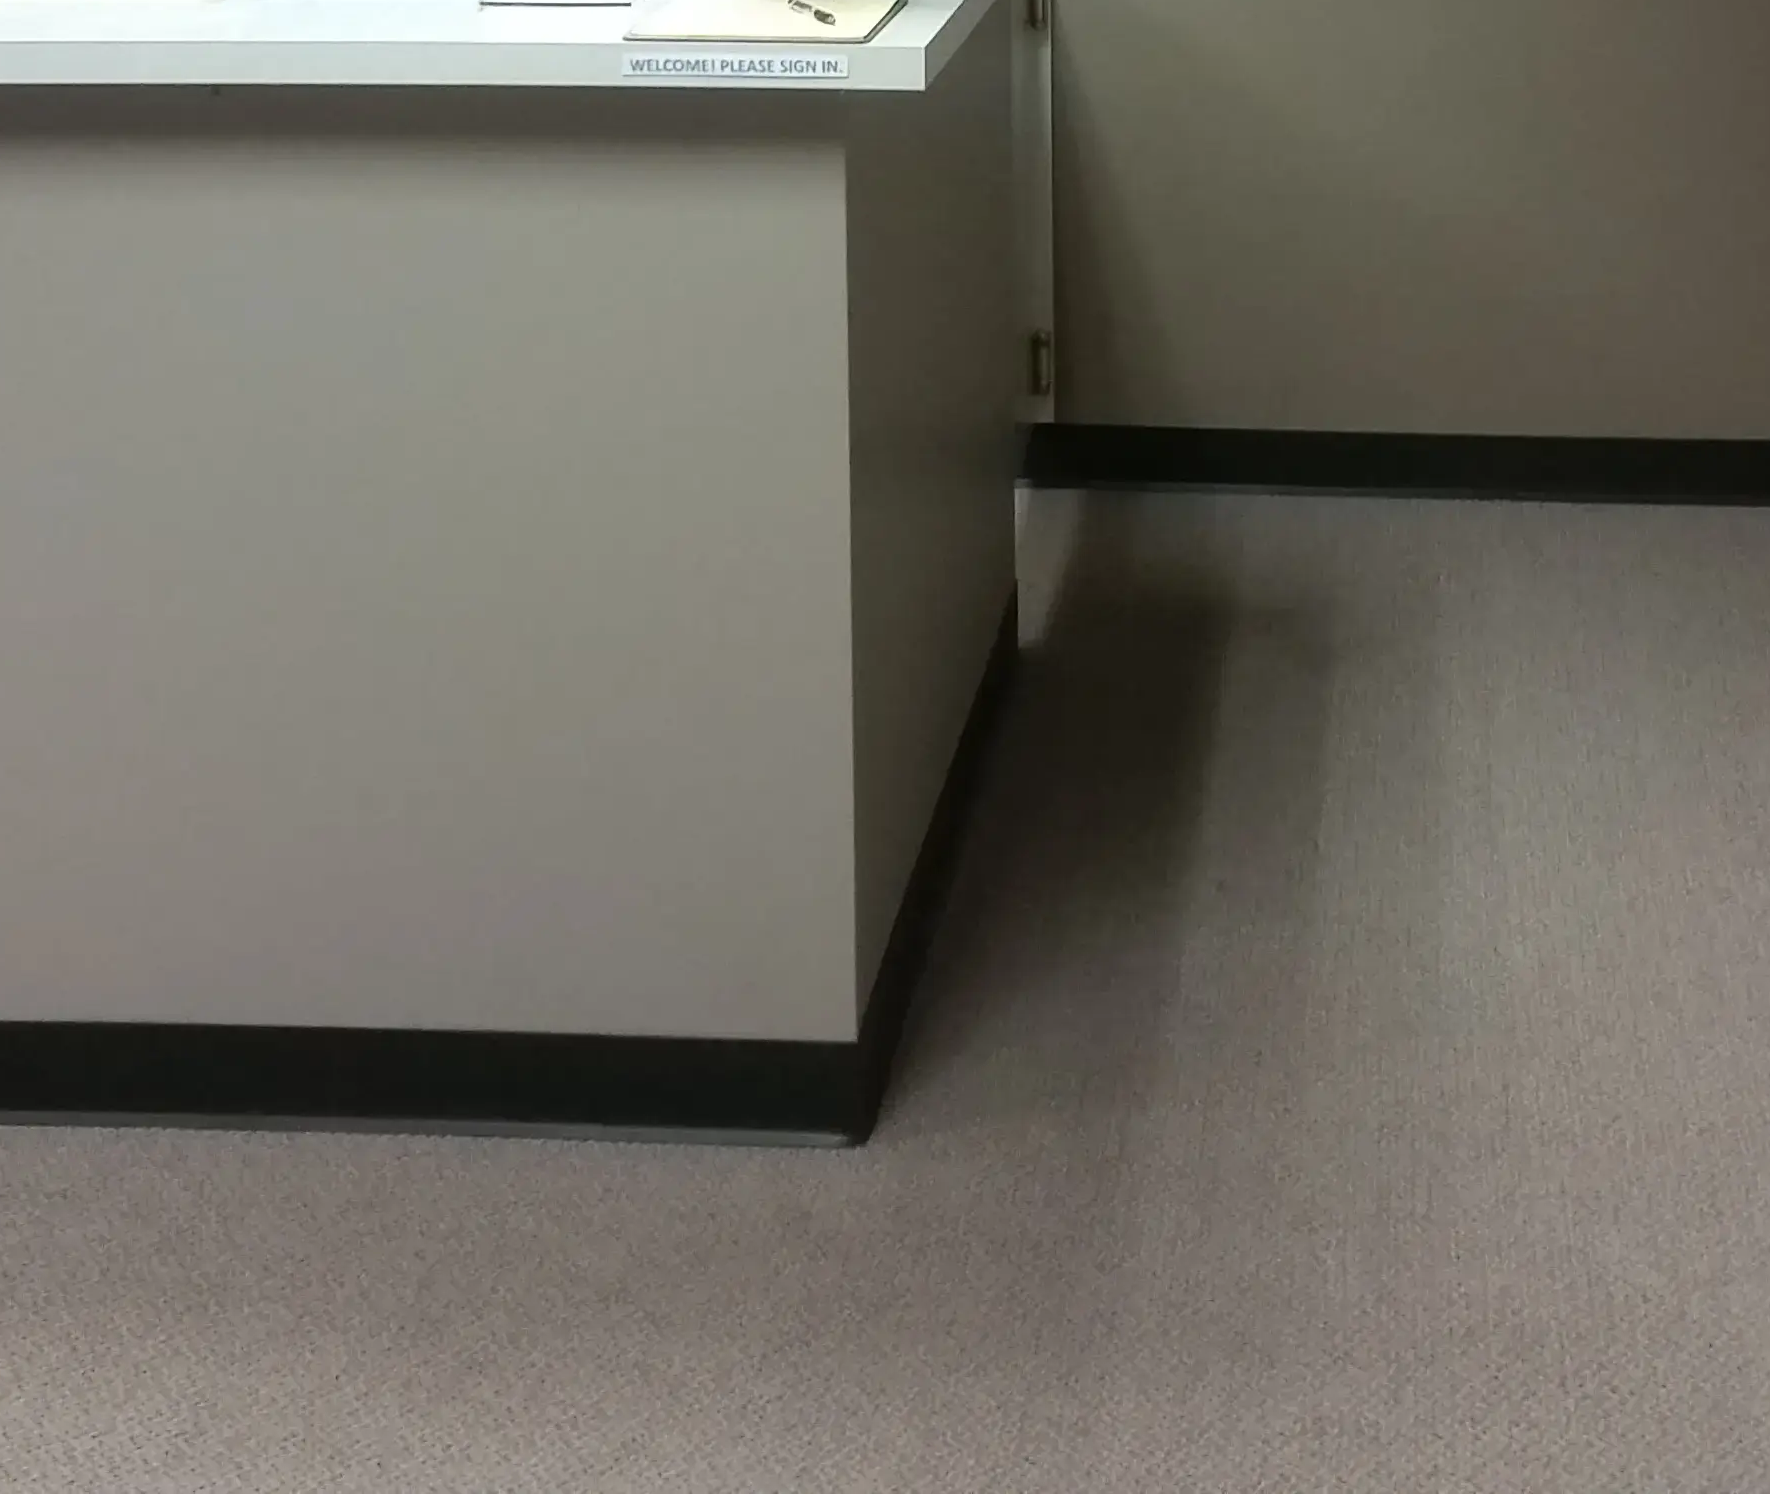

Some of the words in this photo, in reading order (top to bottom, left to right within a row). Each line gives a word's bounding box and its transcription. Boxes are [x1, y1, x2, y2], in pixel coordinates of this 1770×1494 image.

[630, 58, 715, 73] WELCOME!
[720, 59, 775, 73] PLEASE
[780, 59, 818, 74] SIGN
[822, 59, 844, 74] IN.
